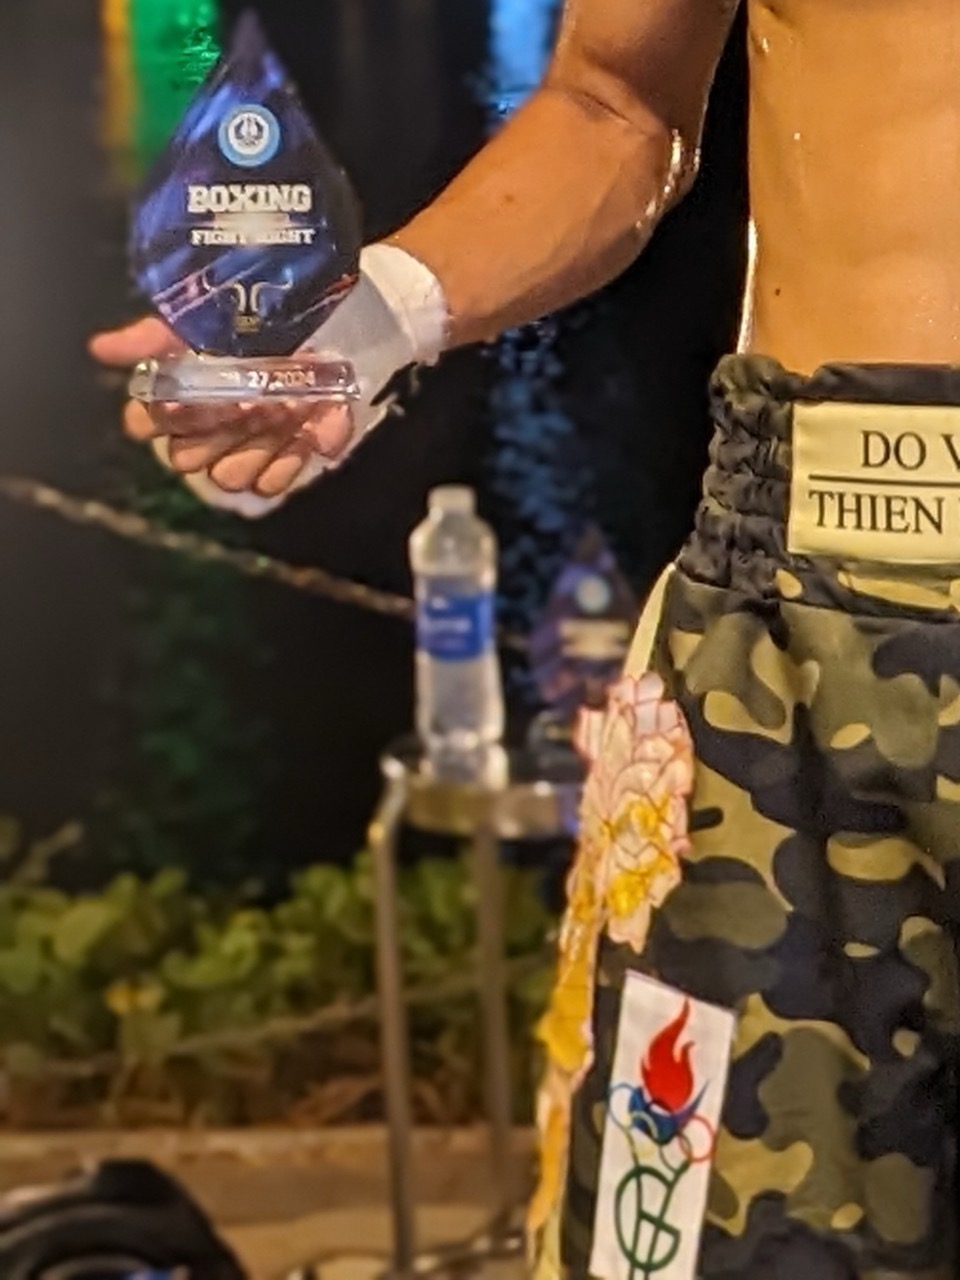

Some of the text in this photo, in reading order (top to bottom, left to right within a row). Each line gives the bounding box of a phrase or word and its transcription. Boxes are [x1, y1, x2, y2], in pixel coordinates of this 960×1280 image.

[187, 184, 312, 212] BOXING
[254, 228, 316, 245] IGHT
[861, 430, 926, 470] DO
[808, 490, 943, 535] THIEN
